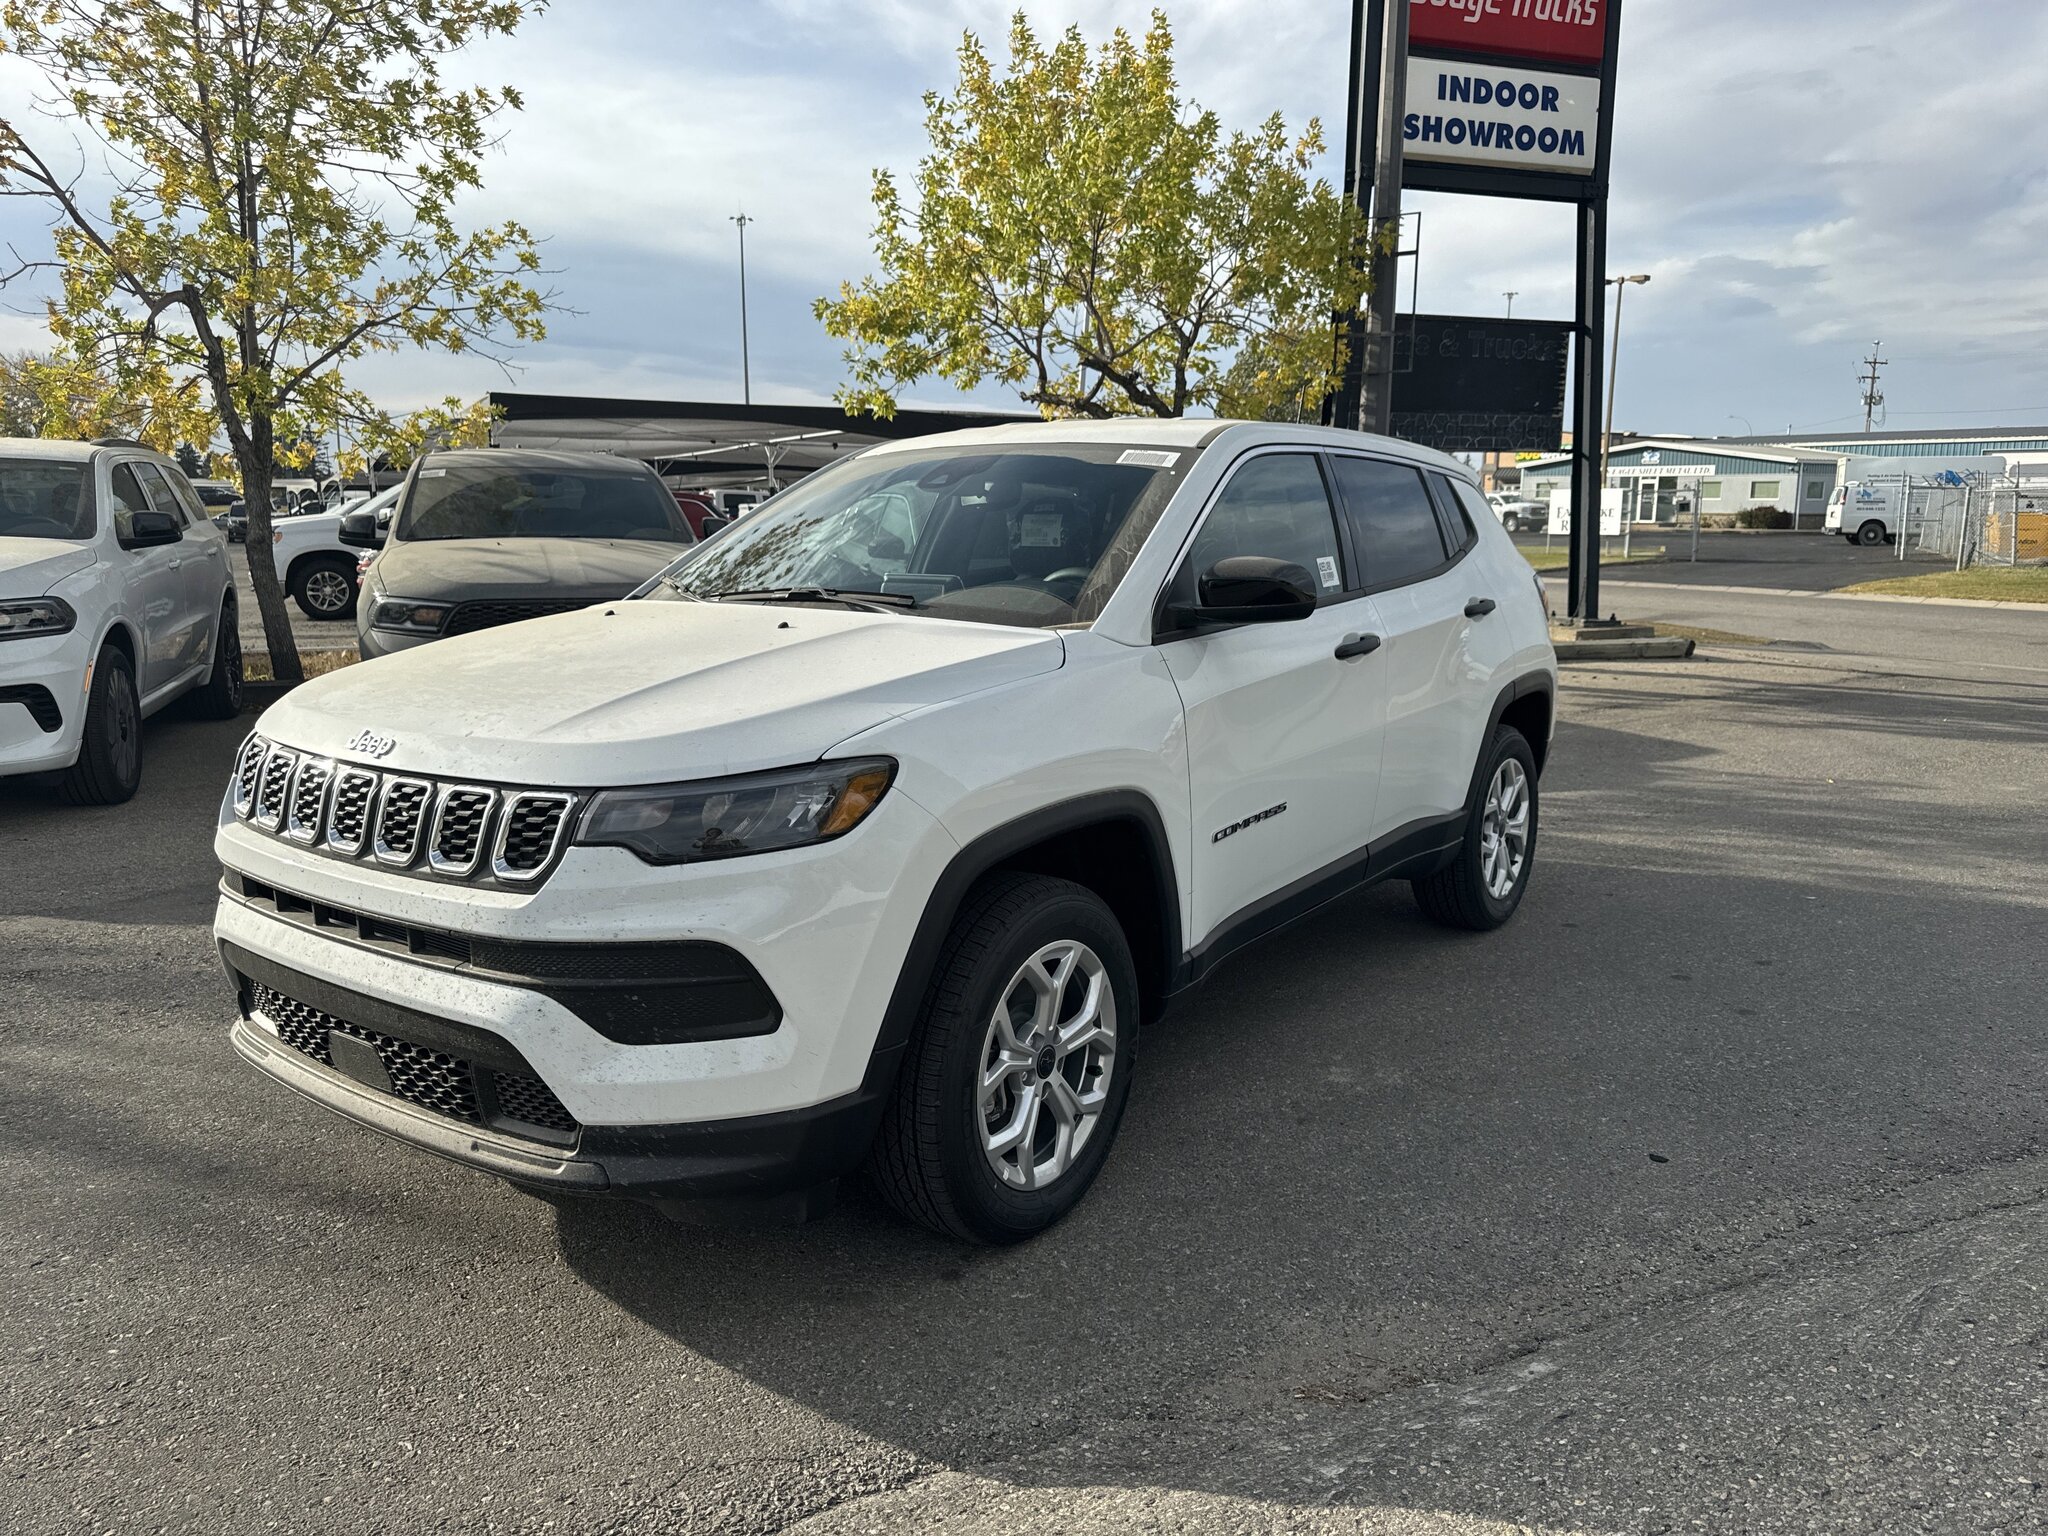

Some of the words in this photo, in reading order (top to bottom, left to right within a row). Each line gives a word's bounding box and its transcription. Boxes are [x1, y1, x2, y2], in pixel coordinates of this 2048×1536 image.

[1438, 74, 1559, 112] INDOOR
[1403, 113, 1585, 156] SHOWROOM
[1665, 467, 1693, 475] METAL
[346, 729, 397, 760] Jeep
[1211, 801, 1288, 844] COMPASS
